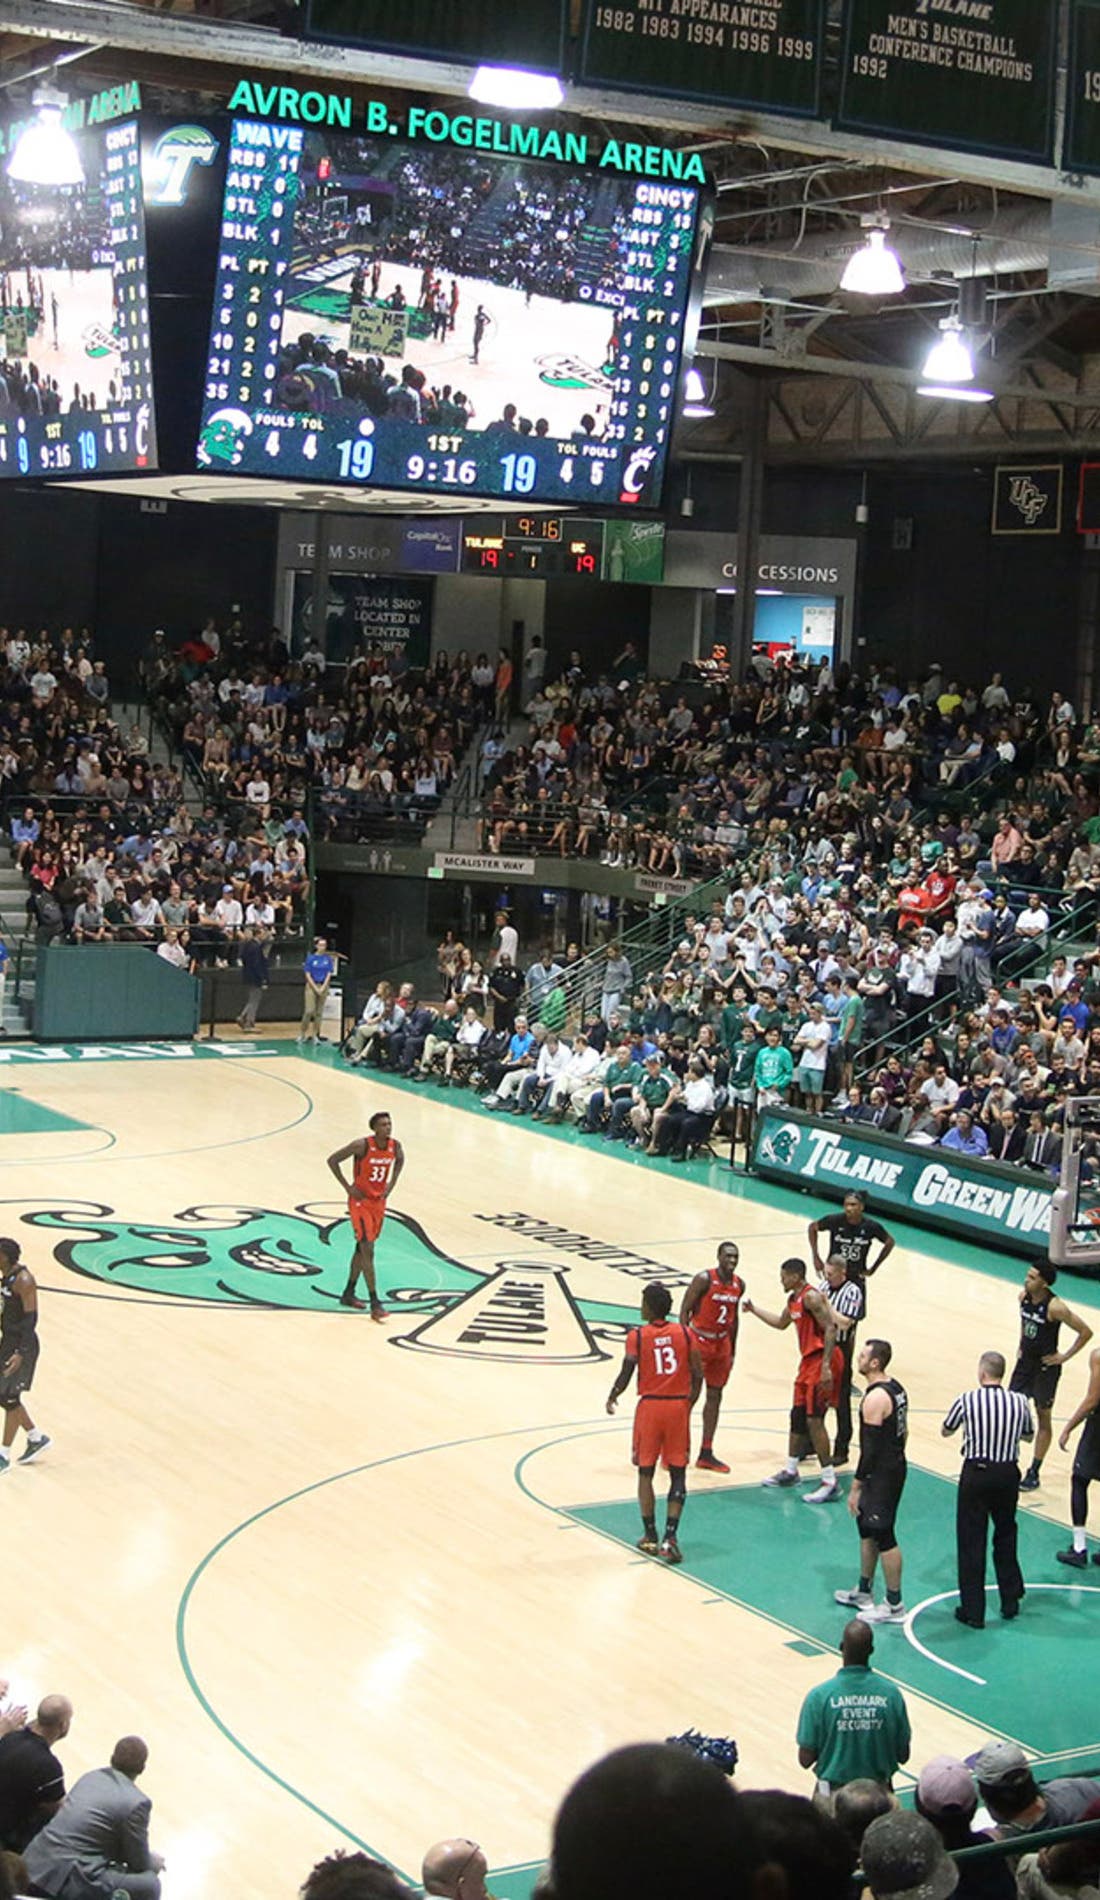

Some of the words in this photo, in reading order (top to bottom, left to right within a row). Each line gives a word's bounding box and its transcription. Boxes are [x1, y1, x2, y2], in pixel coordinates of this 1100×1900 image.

[669, 0, 777, 31] APPEARANCES
[596, 7, 635, 33] 1982
[642, 15, 680, 39] 1983
[687, 22, 724, 47] 1994
[732, 29, 770, 53] 1996
[777, 36, 814, 61] 1999
[888, 14, 929, 40] MEN'S
[932, 23, 1016, 57] BASKETBALL
[853, 55, 888, 79] 1992
[869, 33, 953, 69] CONFERENCE
[957, 51, 1033, 82] CHAMPIONS
[227, 80, 352, 128] AVRON
[367, 101, 398, 135] B.
[408, 107, 587, 164] FOGELMAN
[599, 139, 706, 184] ARENA
[235, 121, 303, 151] WAVE
[278, 154, 299, 173] 11
[226, 171, 264, 191] AST
[635, 184, 695, 208] CINCY
[632, 207, 662, 225] RBS
[673, 213, 691, 230] 13
[223, 221, 258, 241] BLK
[270, 228, 280, 245] 1
[629, 229, 661, 246] AST
[220, 255, 240, 272] PL
[248, 258, 269, 274] PT
[276, 262, 287, 277] F
[627, 252, 655, 269] STL
[667, 256, 677, 271] 2
[222, 284, 234, 300] 3
[249, 286, 262, 304] 2
[273, 289, 283, 306] 1
[624, 276, 656, 293] BLK
[663, 280, 674, 297] 2
[246, 311, 258, 327] 0
[269, 314, 281, 331] 0
[623, 306, 640, 321] PL
[646, 308, 665, 324] PT
[670, 311, 680, 326] F
[212, 332, 234, 350] 10
[244, 336, 256, 354] 2
[268, 339, 278, 356] 1
[623, 331, 632, 348] 1
[207, 357, 231, 375] 21
[241, 361, 253, 378] 2
[264, 363, 275, 380] 0
[619, 354, 630, 371] 2
[642, 357, 653, 373] 0
[662, 359, 673, 375] 0
[205, 384, 228, 401] 35
[239, 385, 250, 402] 3
[263, 388, 273, 405] 1
[614, 378, 632, 394] 13
[639, 380, 650, 396] 0
[660, 382, 671, 398] 0
[611, 400, 629, 416] 15
[636, 403, 647, 419] 3
[658, 406, 668, 421] 1
[255, 412, 295, 429] FOULS
[301, 416, 325, 432] TOL
[427, 434, 462, 452] 1ST
[607, 423, 626, 440] 33
[633, 426, 644, 442] 2
[655, 428, 664, 444] 1
[40, 443, 71, 469] 9:16
[78, 430, 97, 469] 19
[265, 430, 281, 457] 4
[303, 433, 318, 460] 4
[557, 442, 579, 456] TOL
[582, 442, 618, 459] FOULS
[336, 439, 374, 480] 19
[407, 454, 477, 485] 9:16
[500, 453, 537, 493] 19
[559, 458, 573, 484] 4
[590, 461, 604, 486] 5
[519, 518, 559, 539] 9:16
[298, 543, 342, 559] TEM
[347, 546, 391, 560] SHOP
[480, 550, 498, 568] 19
[530, 555, 536, 569] 1
[576, 554, 595, 573] 19
[722, 562, 838, 583] CCESSIONS
[354, 611, 406, 624] LOCATED
[408, 613, 421, 624] IN
[363, 625, 410, 639] CENTER
[444, 857, 500, 869] MCALISTER
[503, 860, 525, 870] WAY
[801, 1127, 904, 1189] TULANE
[369, 1166, 386, 1182] 33
[840, 1244, 861, 1262] 35
[459, 1281, 549, 1346] TULANE
[716, 1304, 727, 1324] 2
[653, 1347, 678, 1375] 13
[830, 1695, 888, 1708] LANDMARK
[842, 1707, 877, 1719] EVENT
[836, 1719, 884, 1730] SECURITY
